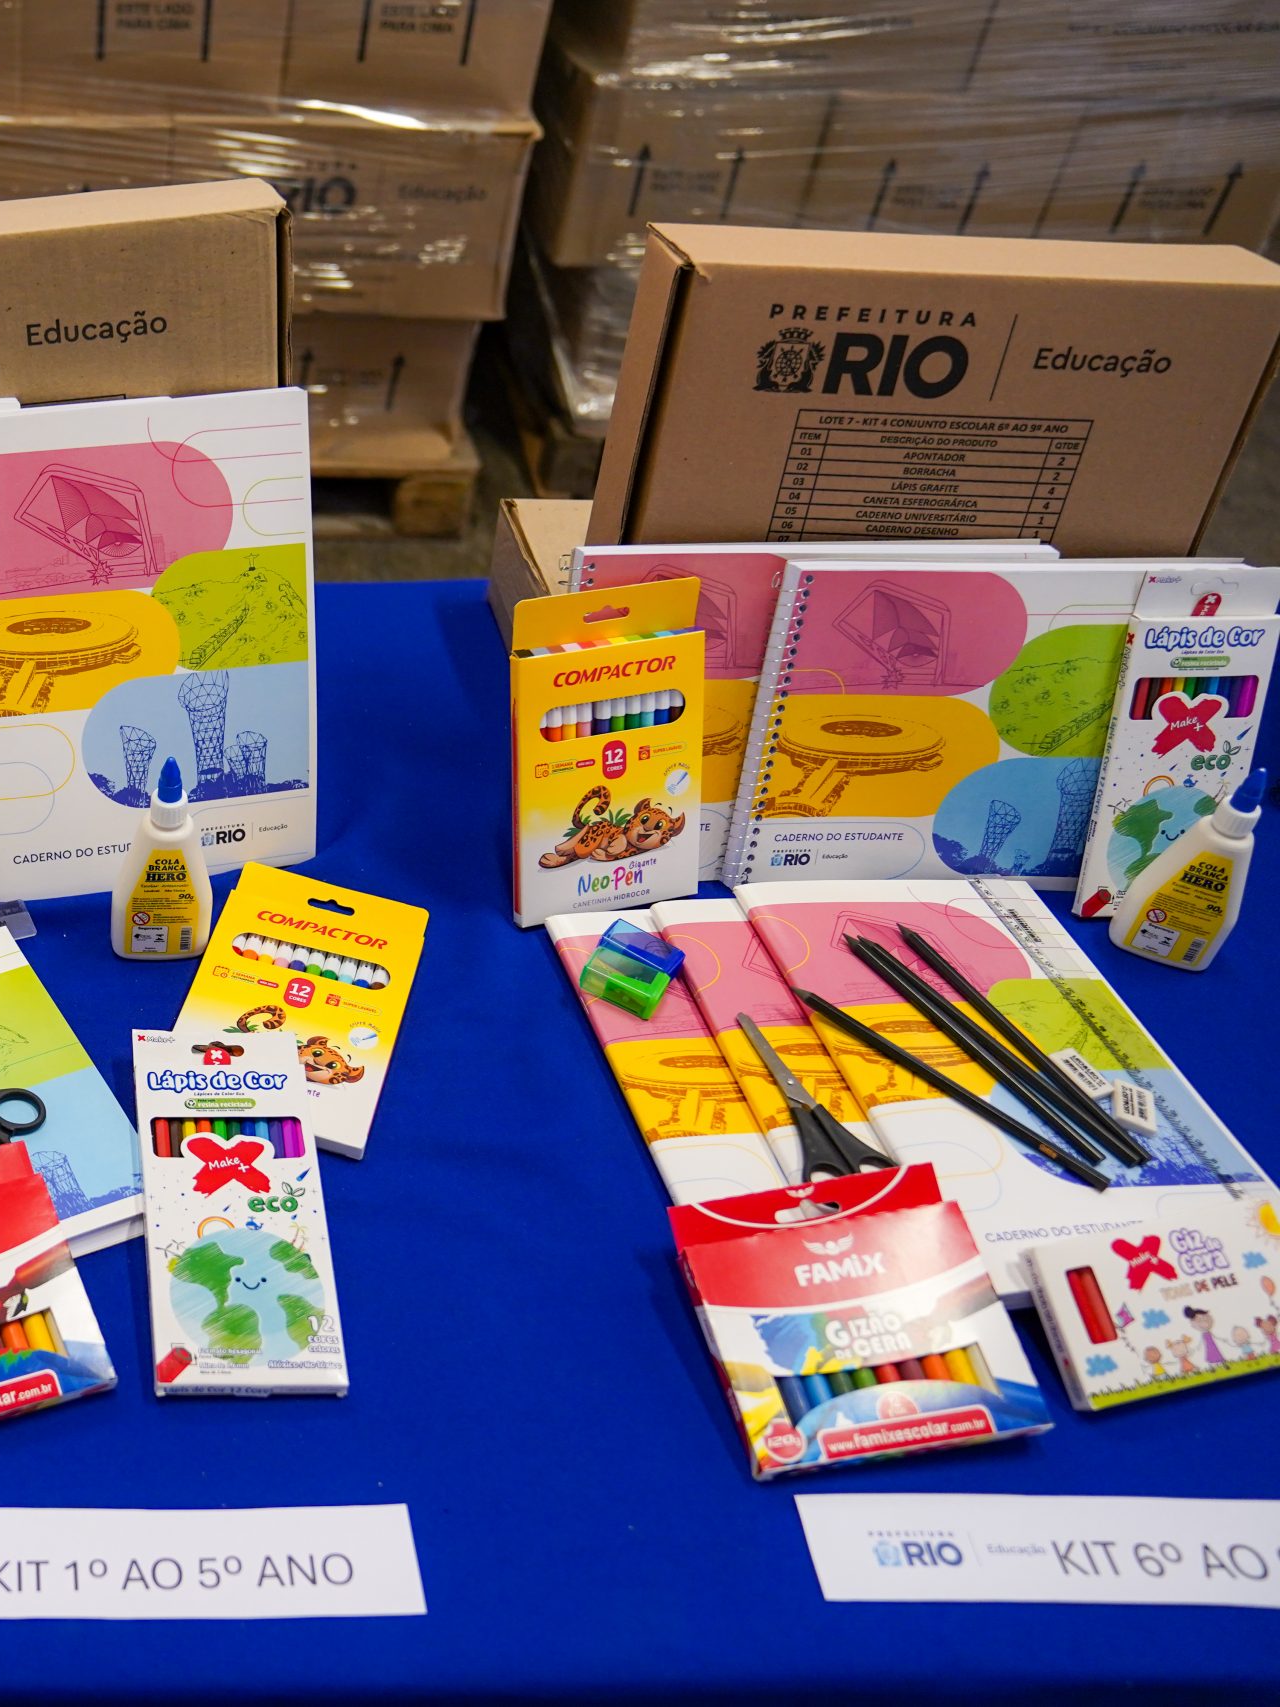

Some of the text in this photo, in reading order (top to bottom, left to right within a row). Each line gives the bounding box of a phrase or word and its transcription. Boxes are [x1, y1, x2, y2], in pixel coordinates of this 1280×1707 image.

[769, 304, 977, 327] PREFEITURA
[26, 311, 167, 346] Educação
[821, 332, 1171, 399] RIO Educação
[819, 416, 844, 425] LOTE
[846, 417, 854, 425] 7
[862, 418, 879, 426] KIT
[880, 418, 888, 426] 4
[890, 418, 947, 430] CONJUNTO
[949, 421, 995, 431] ESCOLAR
[1011, 423, 1027, 432] AO
[1043, 425, 1068, 433] ANO
[799, 432, 1080, 450] ITEM DESCRIÇÃO DO PRODUTO QTDE
[800, 448, 1065, 466] 01 APONTADOR 2
[796, 463, 1060, 481] 02 BORRACHA 2
[792, 477, 1055, 496] 03 LÁPIS GRAFITE 4
[789, 492, 1050, 510] 04 CANETA ESFEROGRÁFICA 4
[785, 507, 1044, 525] 05 CADERNO UNIVERSITÁRIO 1
[781, 521, 793, 529] 06
[865, 524, 912, 534] CADERNO
[913, 527, 959, 536] DESENHO
[1144, 625, 1265, 652] Lápis de Cor
[552, 655, 676, 688] COMPACTOR
[604, 748, 624, 765] 12
[1190, 751, 1232, 771] eco
[606, 763, 624, 773] CORES
[215, 823, 288, 845] RIO Educação
[774, 831, 904, 842] CADERNO DO ESTUDANTE
[13, 849, 71, 865] CADERNO
[75, 847, 94, 858] DO
[628, 856, 657, 871] Gigante
[783, 852, 848, 866] RIO Educação
[145, 872, 187, 881] HERO
[148, 864, 186, 872] BRANCA
[1188, 865, 1229, 882] BRANCA
[1199, 861, 1226, 874] COLA
[577, 865, 644, 897] Neo-Pen
[1181, 872, 1226, 892] HERO
[572, 887, 650, 909] CANETINHA HIDROCOR
[256, 909, 389, 951] COMPACTOR
[288, 983, 312, 998] 12
[288, 995, 307, 1004] CORES
[147, 1069, 288, 1094] Lápis de Cor
[247, 1196, 299, 1213] eco
[985, 1225, 1072, 1244] CADERNO DO
[1169, 1227, 1205, 1254] Giz
[1177, 1250, 1231, 1276] Cera
[307, 1314, 335, 1334] 12
[826, 1416, 987, 1454] www.famixescolar.com.br
[901, 1540, 1046, 1568] RIO Educação
[1050, 1540, 1270, 1581] KIT 6º AO
[65, 1558, 108, 1592] 1º
[121, 1556, 183, 1592] AO
[198, 1554, 242, 1590] 5º
[256, 1552, 354, 1588] ANO
